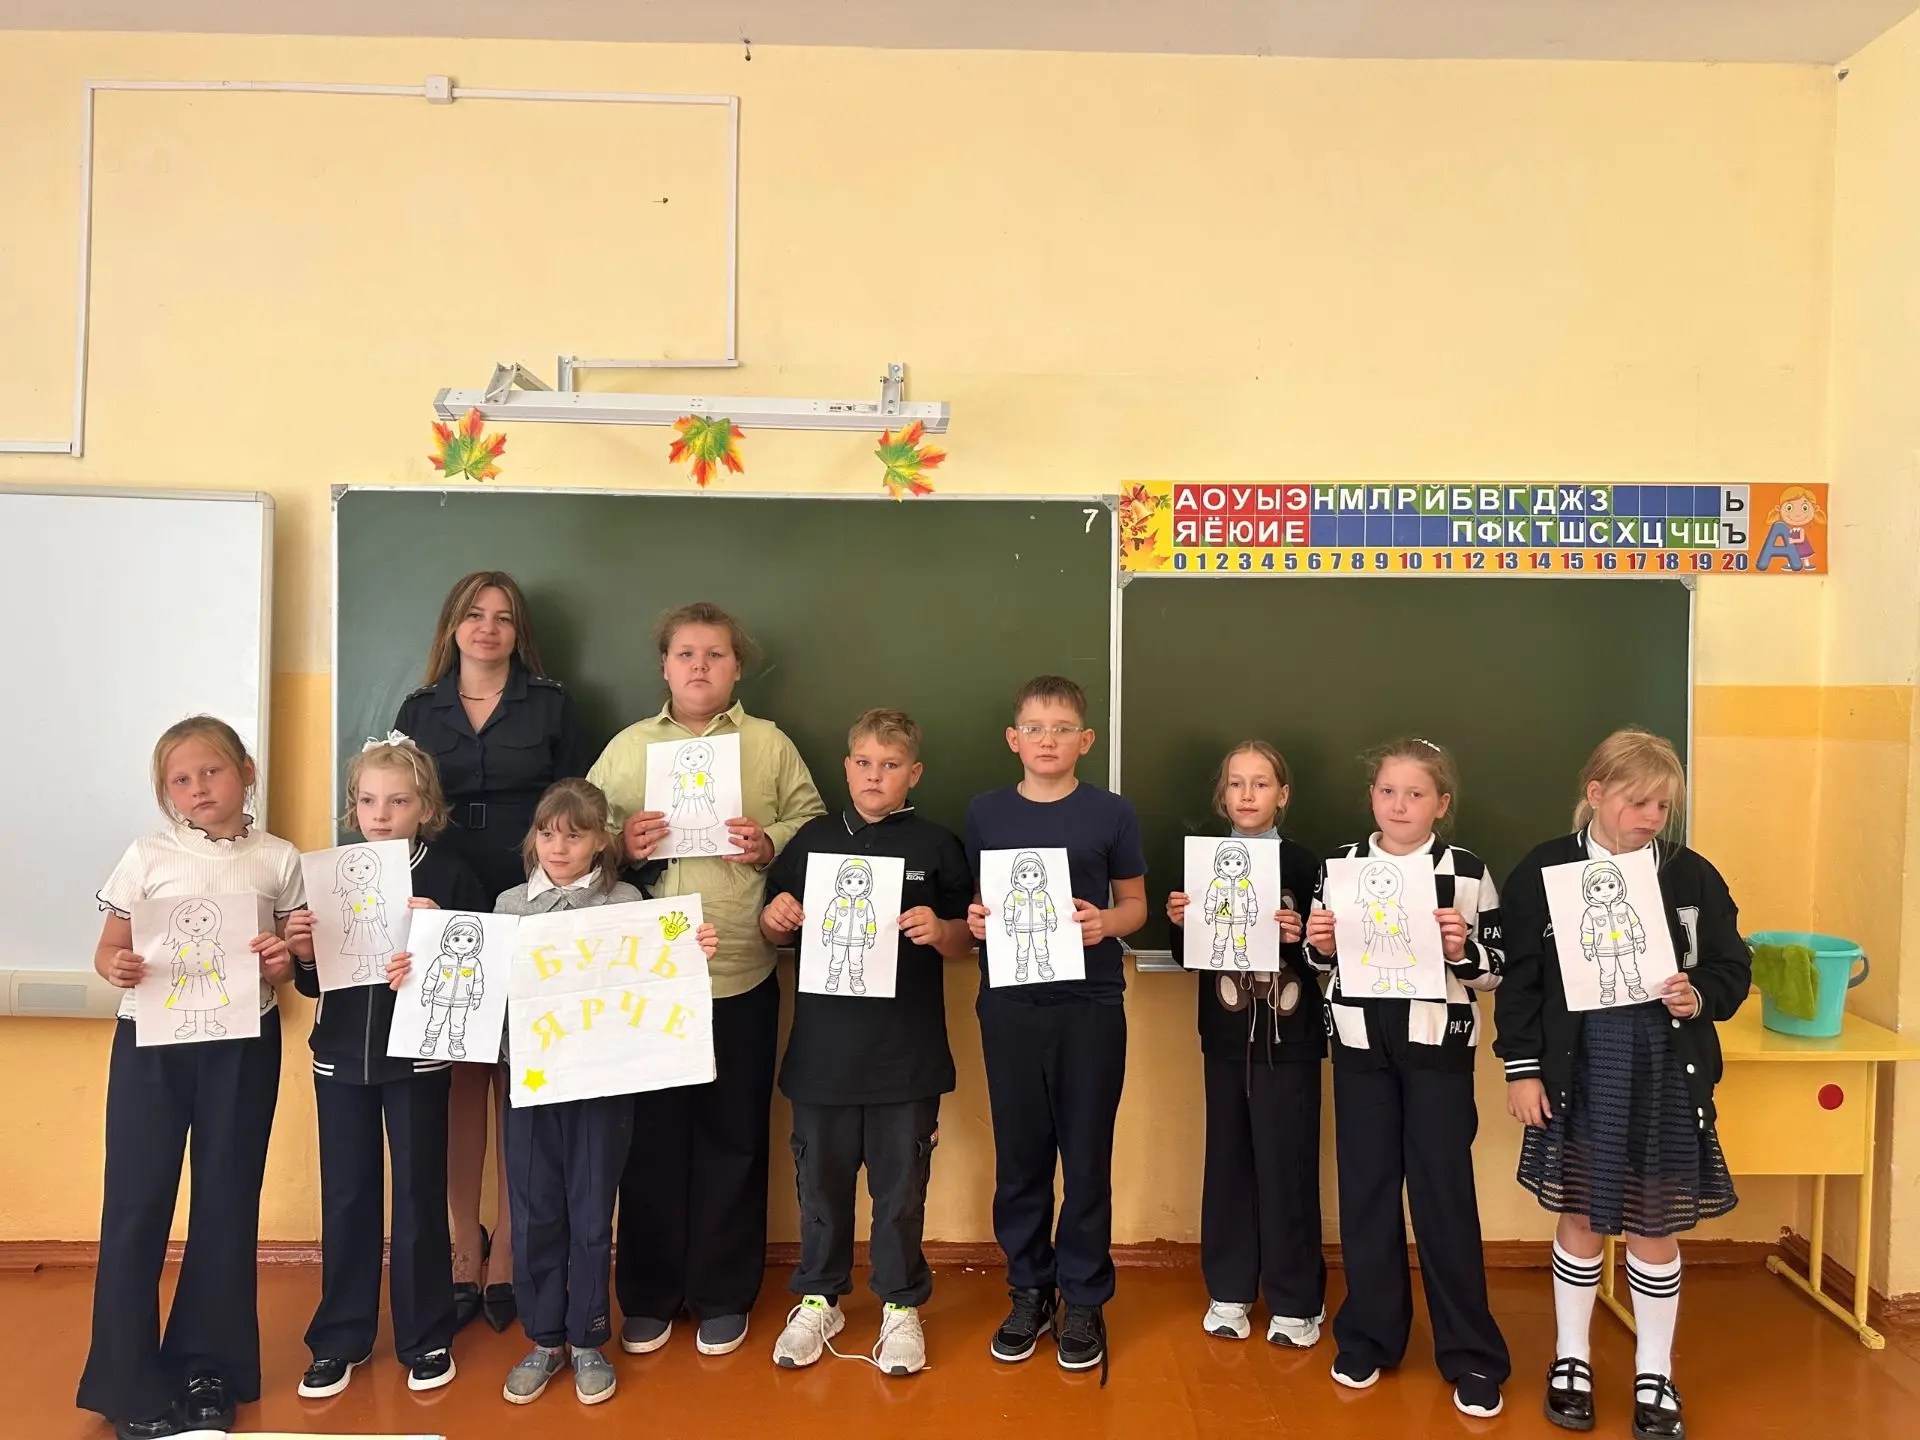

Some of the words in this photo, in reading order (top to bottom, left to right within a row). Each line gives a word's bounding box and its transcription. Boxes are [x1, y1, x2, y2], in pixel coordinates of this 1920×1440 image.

[1083, 508, 1099, 533] 7
[1173, 553, 1187, 570] 0
[1196, 554, 1207, 569] 1
[1215, 553, 1229, 570] 2
[1238, 553, 1252, 571] 3
[1260, 553, 1275, 569] 4
[1284, 553, 1298, 570] 5
[1307, 553, 1321, 570] 6
[1330, 553, 1342, 569] 7
[1351, 553, 1365, 570] 8
[1375, 553, 1388, 569] 9
[1399, 552, 1423, 570] 10
[1432, 552, 1453, 569] 11
[1462, 552, 1484, 569] 12
[1494, 552, 1519, 569] 13
[1528, 552, 1551, 569] 14
[1560, 552, 1584, 570] 15
[1593, 552, 1616, 570] 16
[1626, 552, 1648, 570] 17
[1655, 552, 1679, 570] 18
[1688, 553, 1712, 570] 19
[1722, 553, 1749, 571] 20
[530, 935, 678, 981] БУДЬ
[531, 990, 696, 1052] ЯРЧЕ
